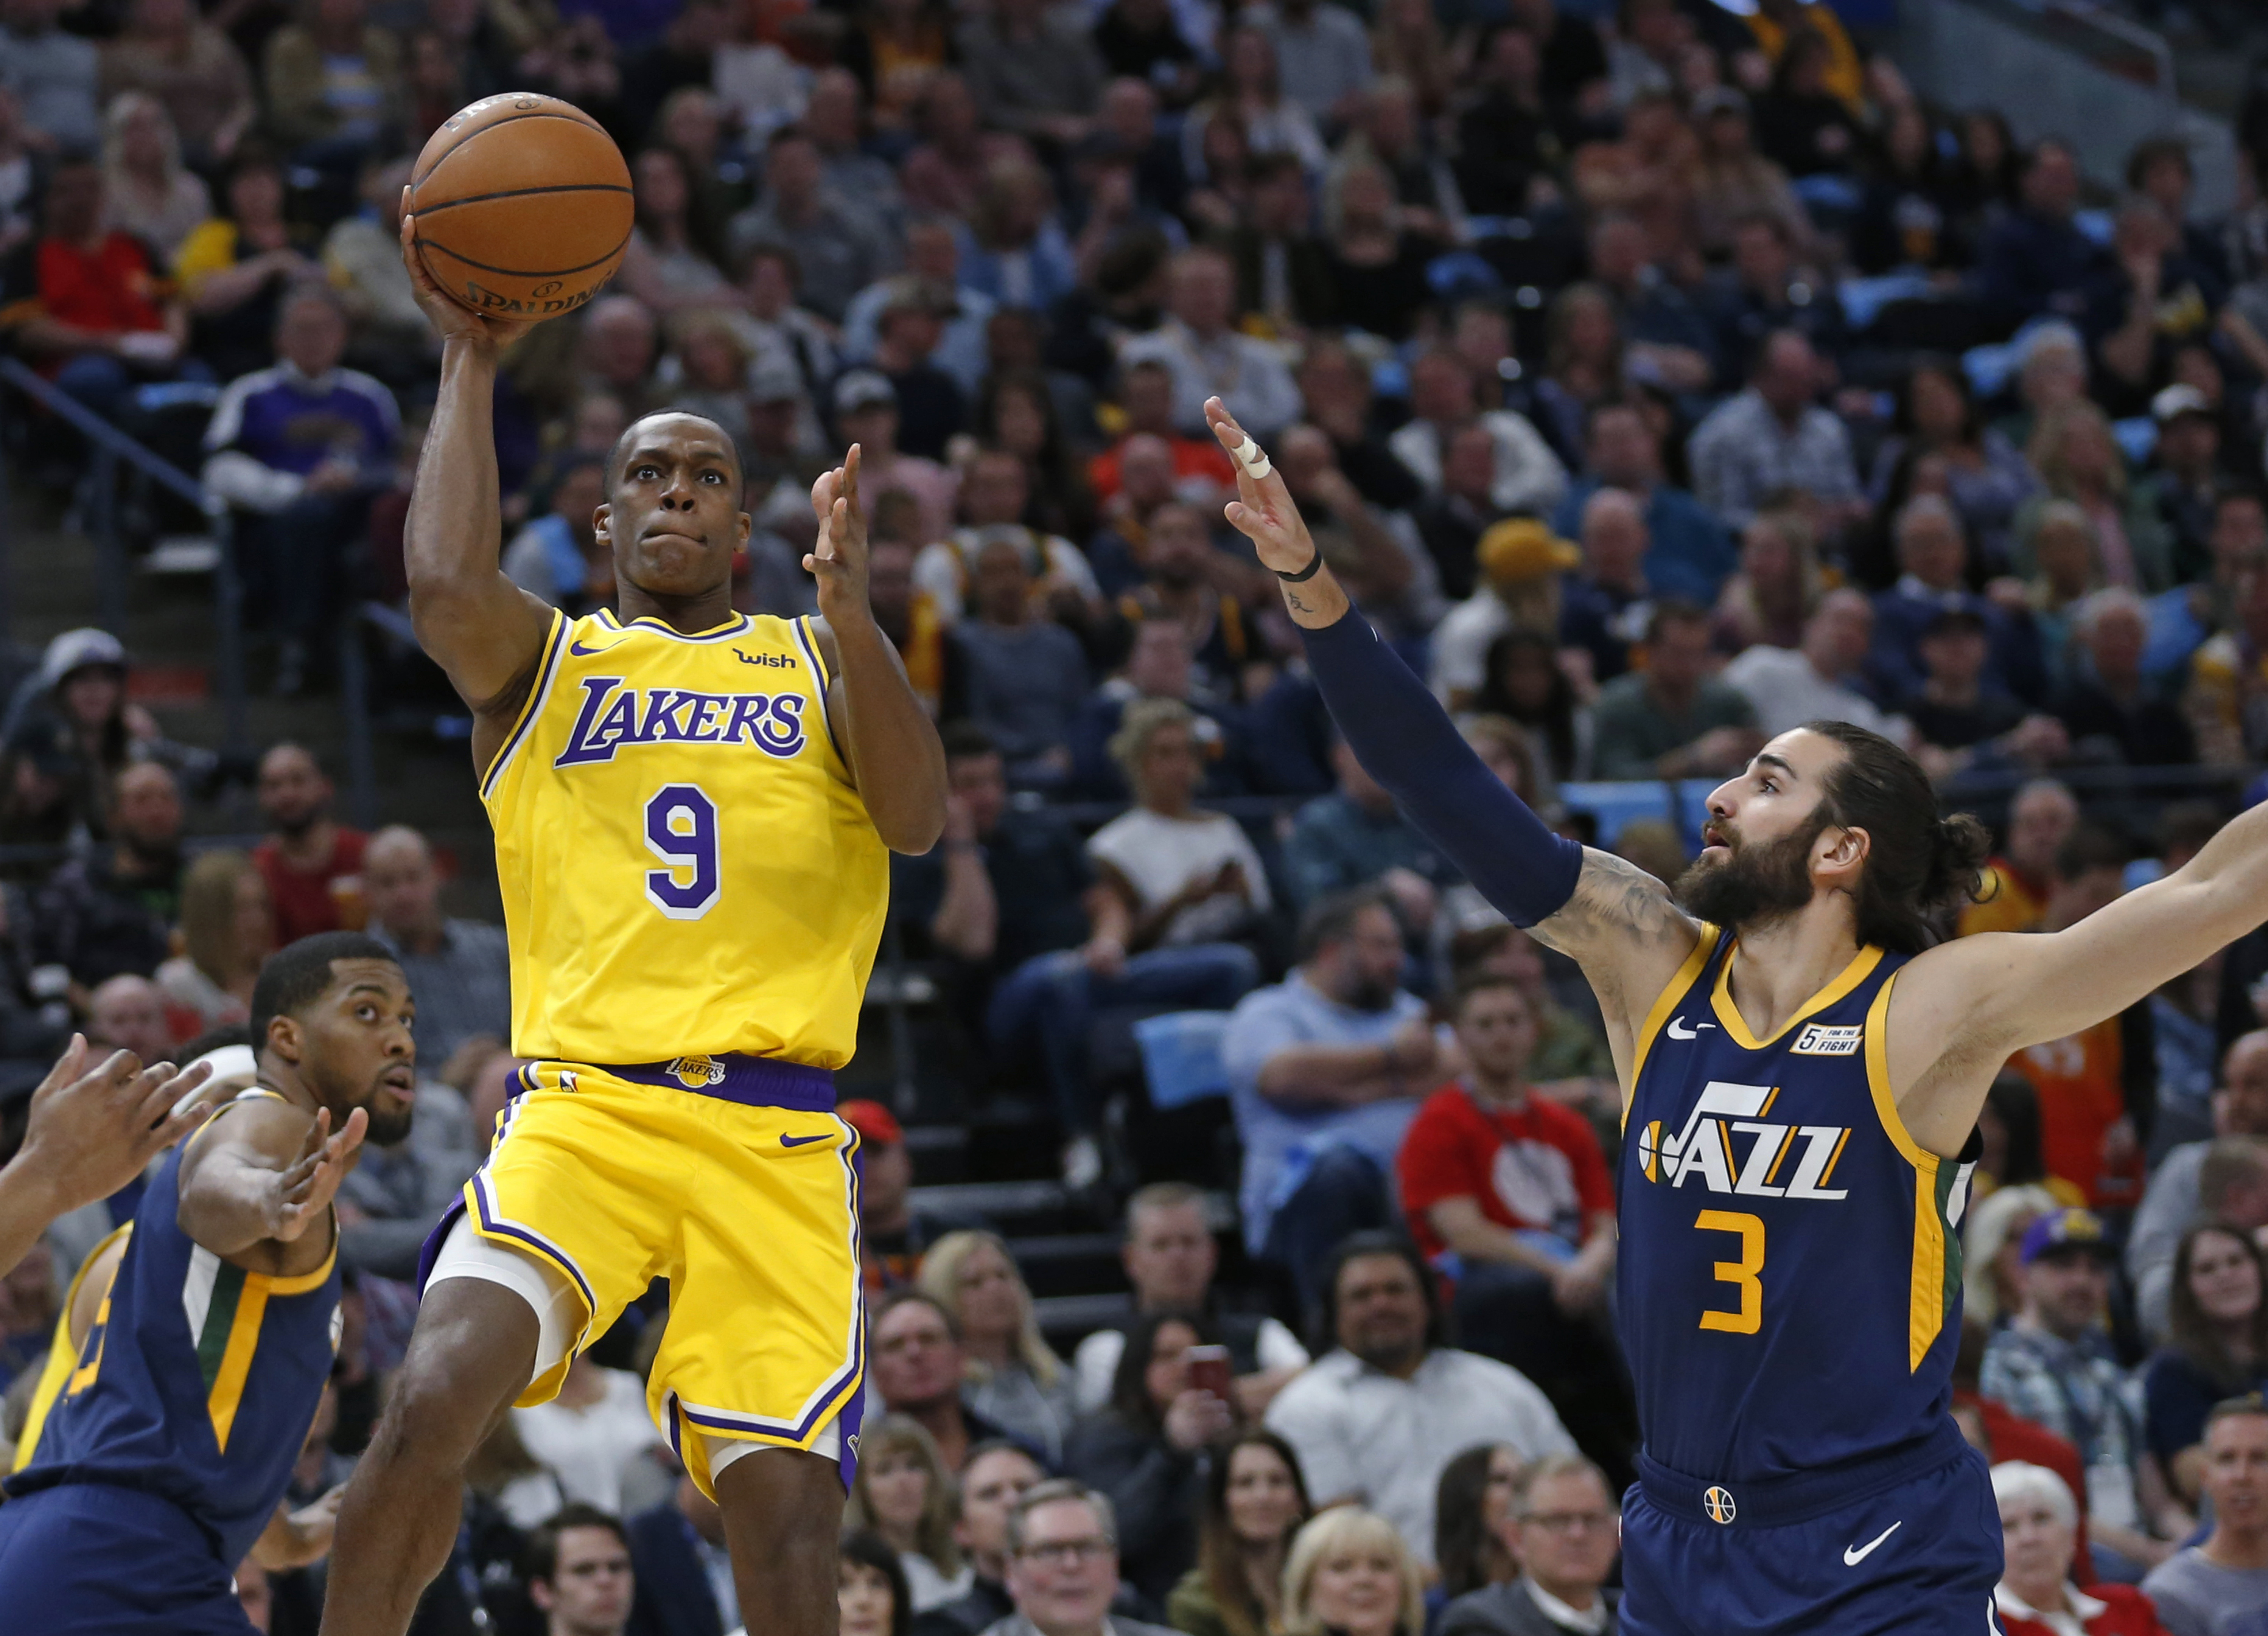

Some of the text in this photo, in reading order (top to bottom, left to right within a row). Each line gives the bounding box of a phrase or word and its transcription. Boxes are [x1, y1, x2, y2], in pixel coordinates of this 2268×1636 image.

[732, 648, 796, 668] wish
[554, 676, 807, 769] LAKERS
[643, 783, 721, 920] 9
[1799, 1028, 1822, 1050] 5
[1817, 1041, 1856, 1051] FIGHT
[670, 1056, 724, 1083] LAKERS
[1638, 1081, 1851, 1200] JAZZ
[1694, 1209, 1766, 1335] 3
